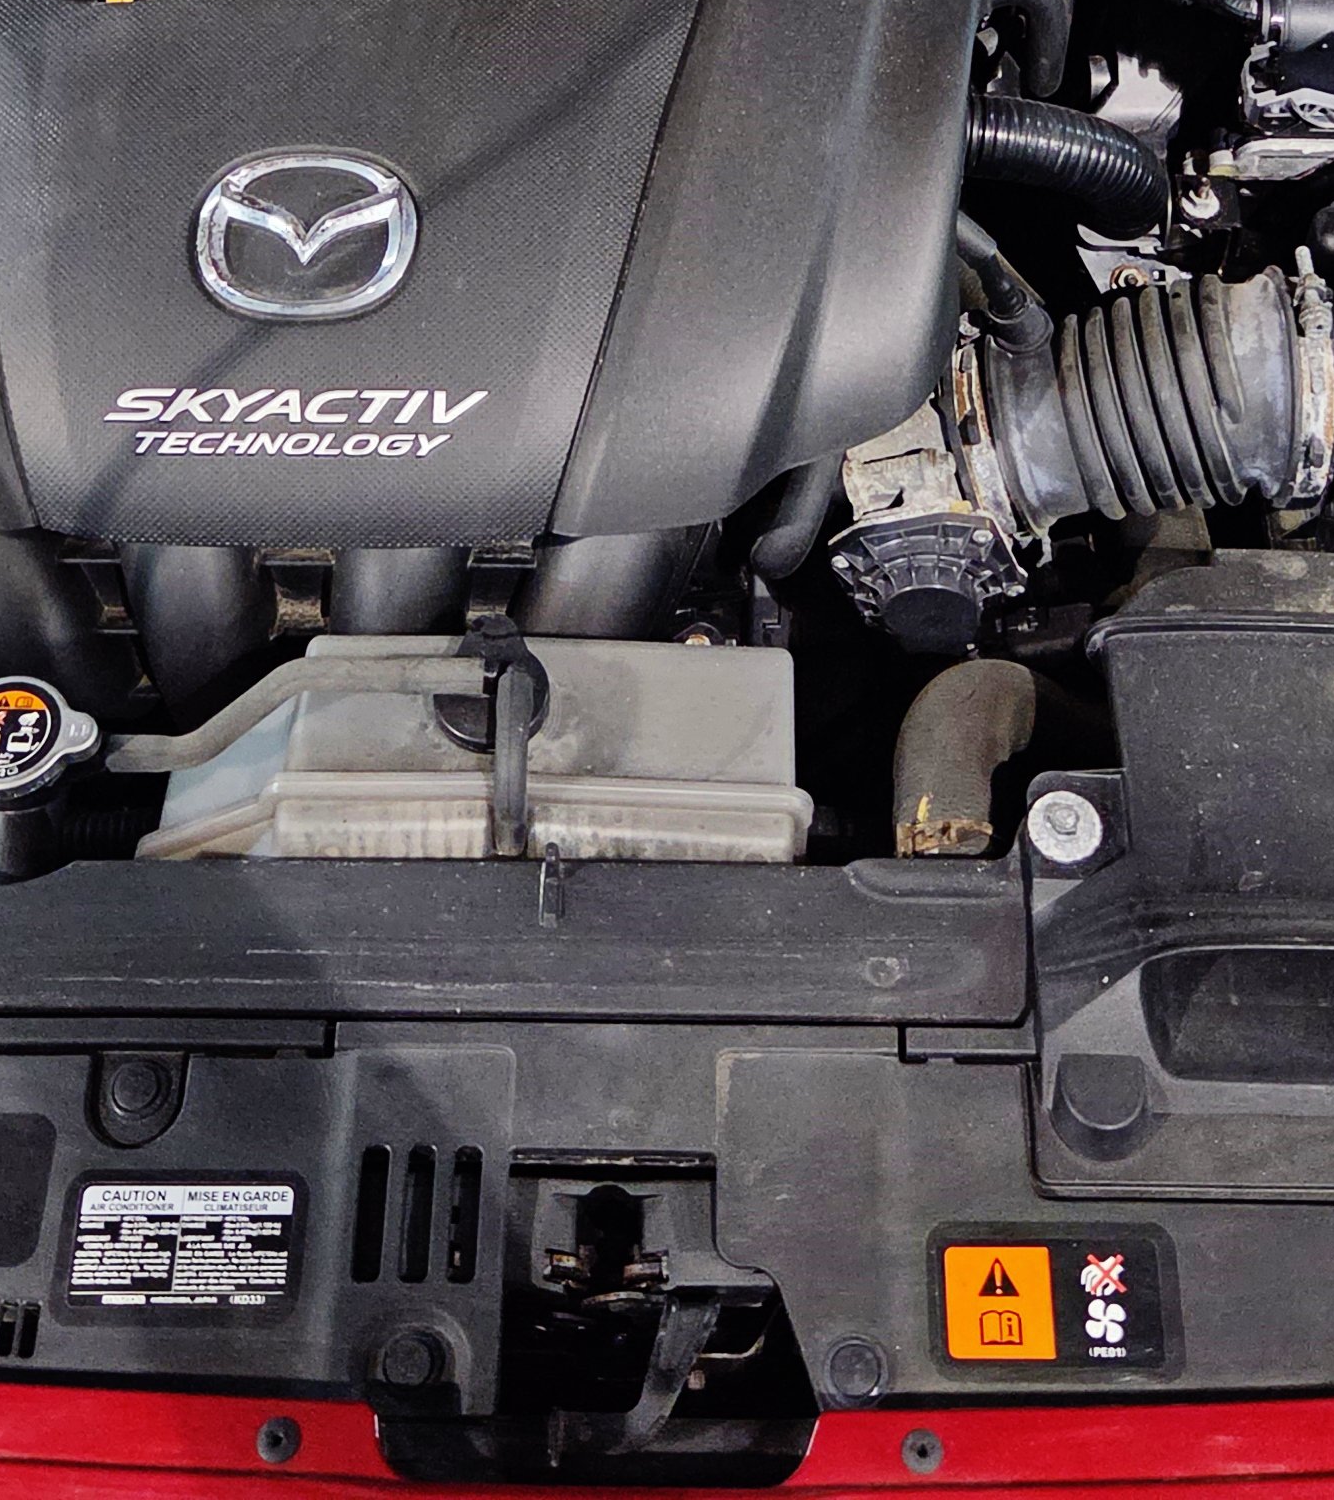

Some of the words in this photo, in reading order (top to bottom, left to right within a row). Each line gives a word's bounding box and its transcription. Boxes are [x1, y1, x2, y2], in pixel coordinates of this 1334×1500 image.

[104, 387, 488, 425] SKYACTIV
[134, 431, 453, 457] TECHNOLOGY
[101, 1190, 167, 1202] CAUTION
[187, 1190, 219, 1202] MISE
[222, 1190, 241, 1202] EN
[242, 1191, 289, 1202] GARDE
[90, 1203, 106, 1211] AIR
[108, 1203, 175, 1211] CONDITIONER
[203, 1203, 269, 1211] CLIMATISEUR
